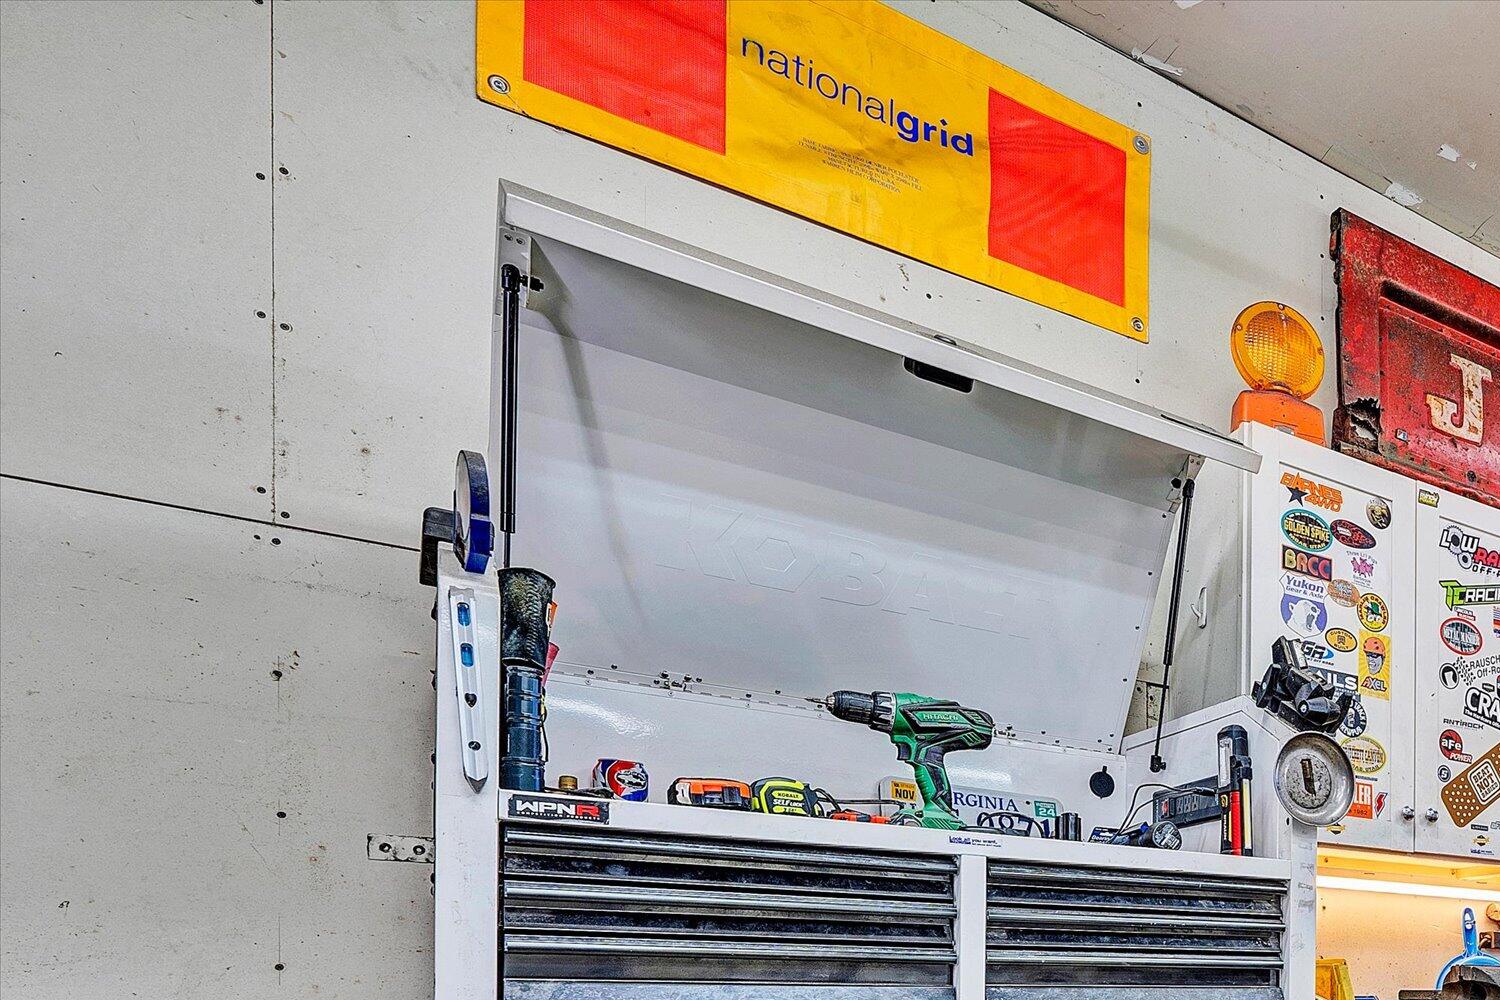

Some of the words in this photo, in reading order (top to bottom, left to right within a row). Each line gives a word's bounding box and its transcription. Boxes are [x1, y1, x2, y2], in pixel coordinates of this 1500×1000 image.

[741, 36, 975, 157] nationalgrid
[1439, 525, 1480, 557] LOW
[1285, 575, 1324, 594] Yukon
[1285, 586, 1302, 596] Gear
[1310, 590, 1324, 600] Axle
[1469, 653, 1500, 669] RAUSCH
[1441, 738, 1462, 750] aFe
[1472, 765, 1490, 784] BEAT
[1476, 773, 1495, 793] NOT
[777, 791, 800, 799] KOBALT
[894, 788, 915, 801] NOV
[952, 792, 1019, 812] RGINIA
[516, 800, 600, 817] WPNR
[1038, 808, 1056, 817] 24
